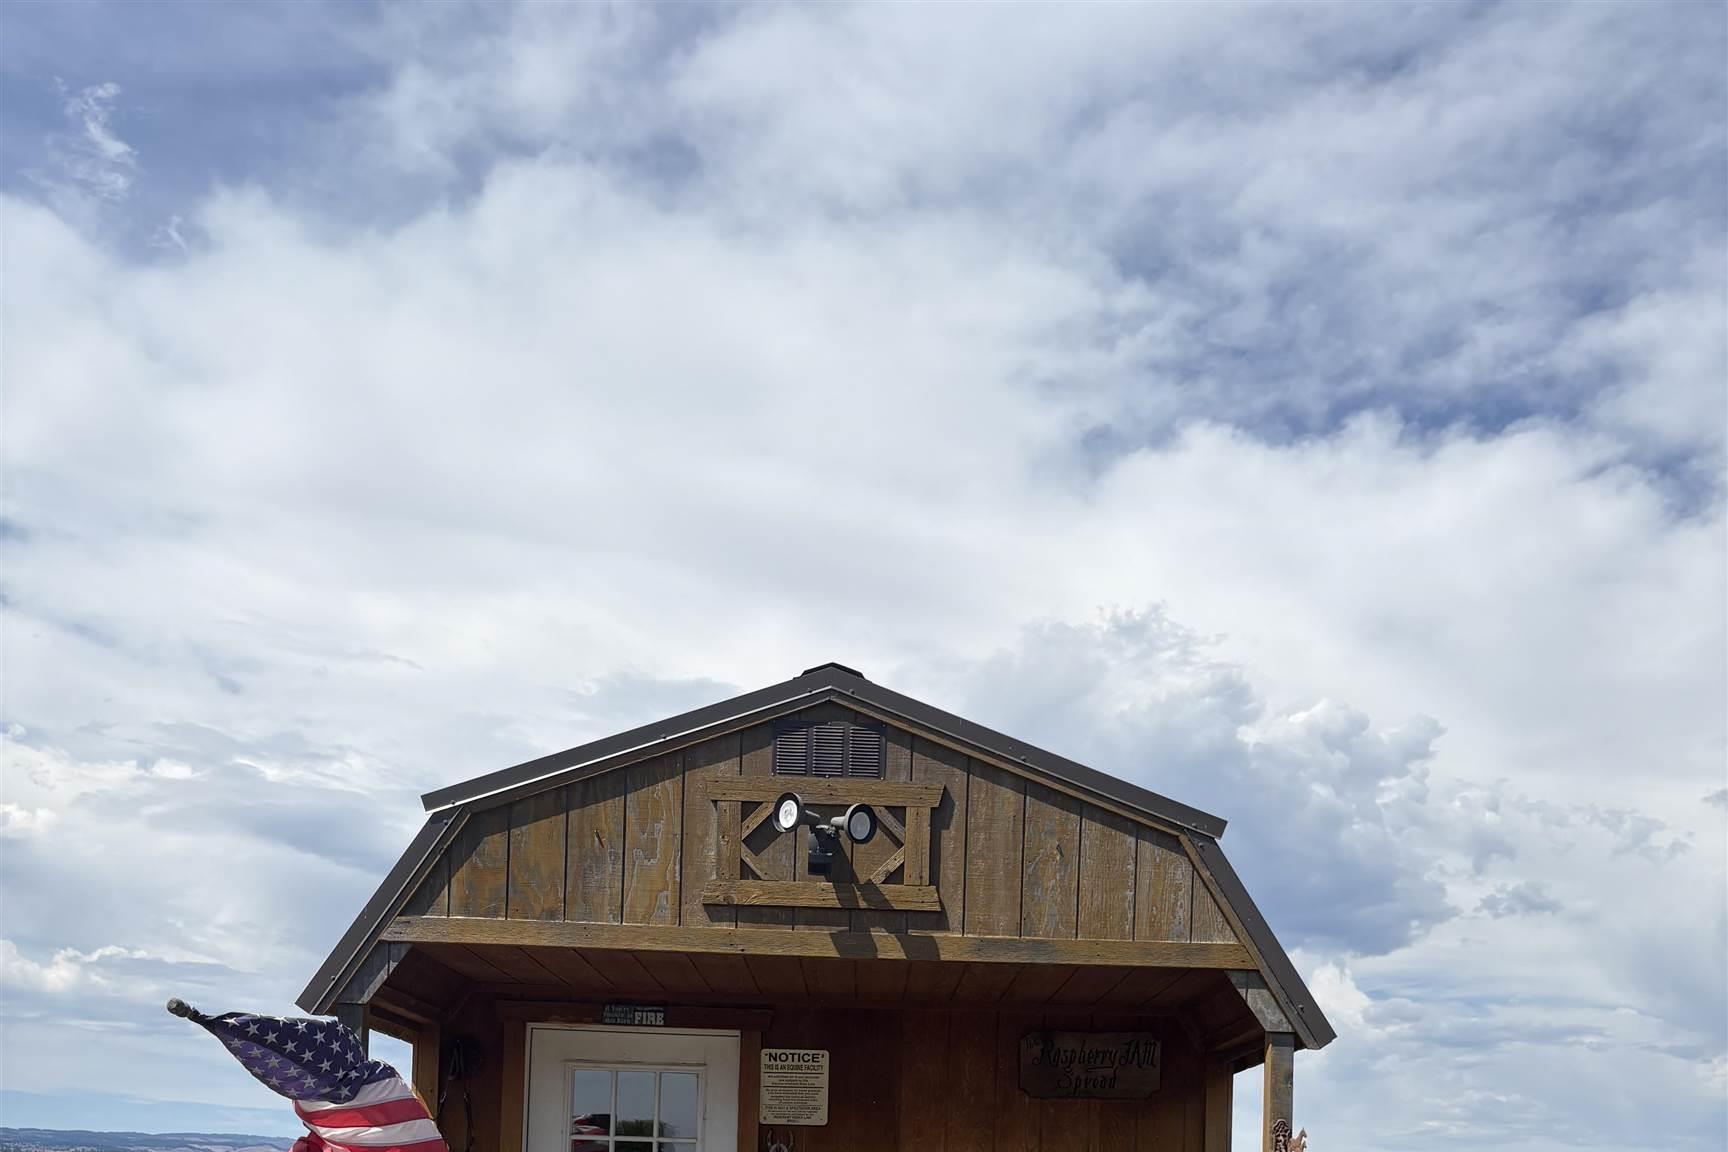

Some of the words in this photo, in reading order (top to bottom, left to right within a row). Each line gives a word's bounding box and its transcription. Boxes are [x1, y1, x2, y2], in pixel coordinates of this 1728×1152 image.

[764, 1063, 774, 1071] THIS
[804, 1064, 824, 1072] FACILITY
[1056, 1066, 1118, 1095] Spread
